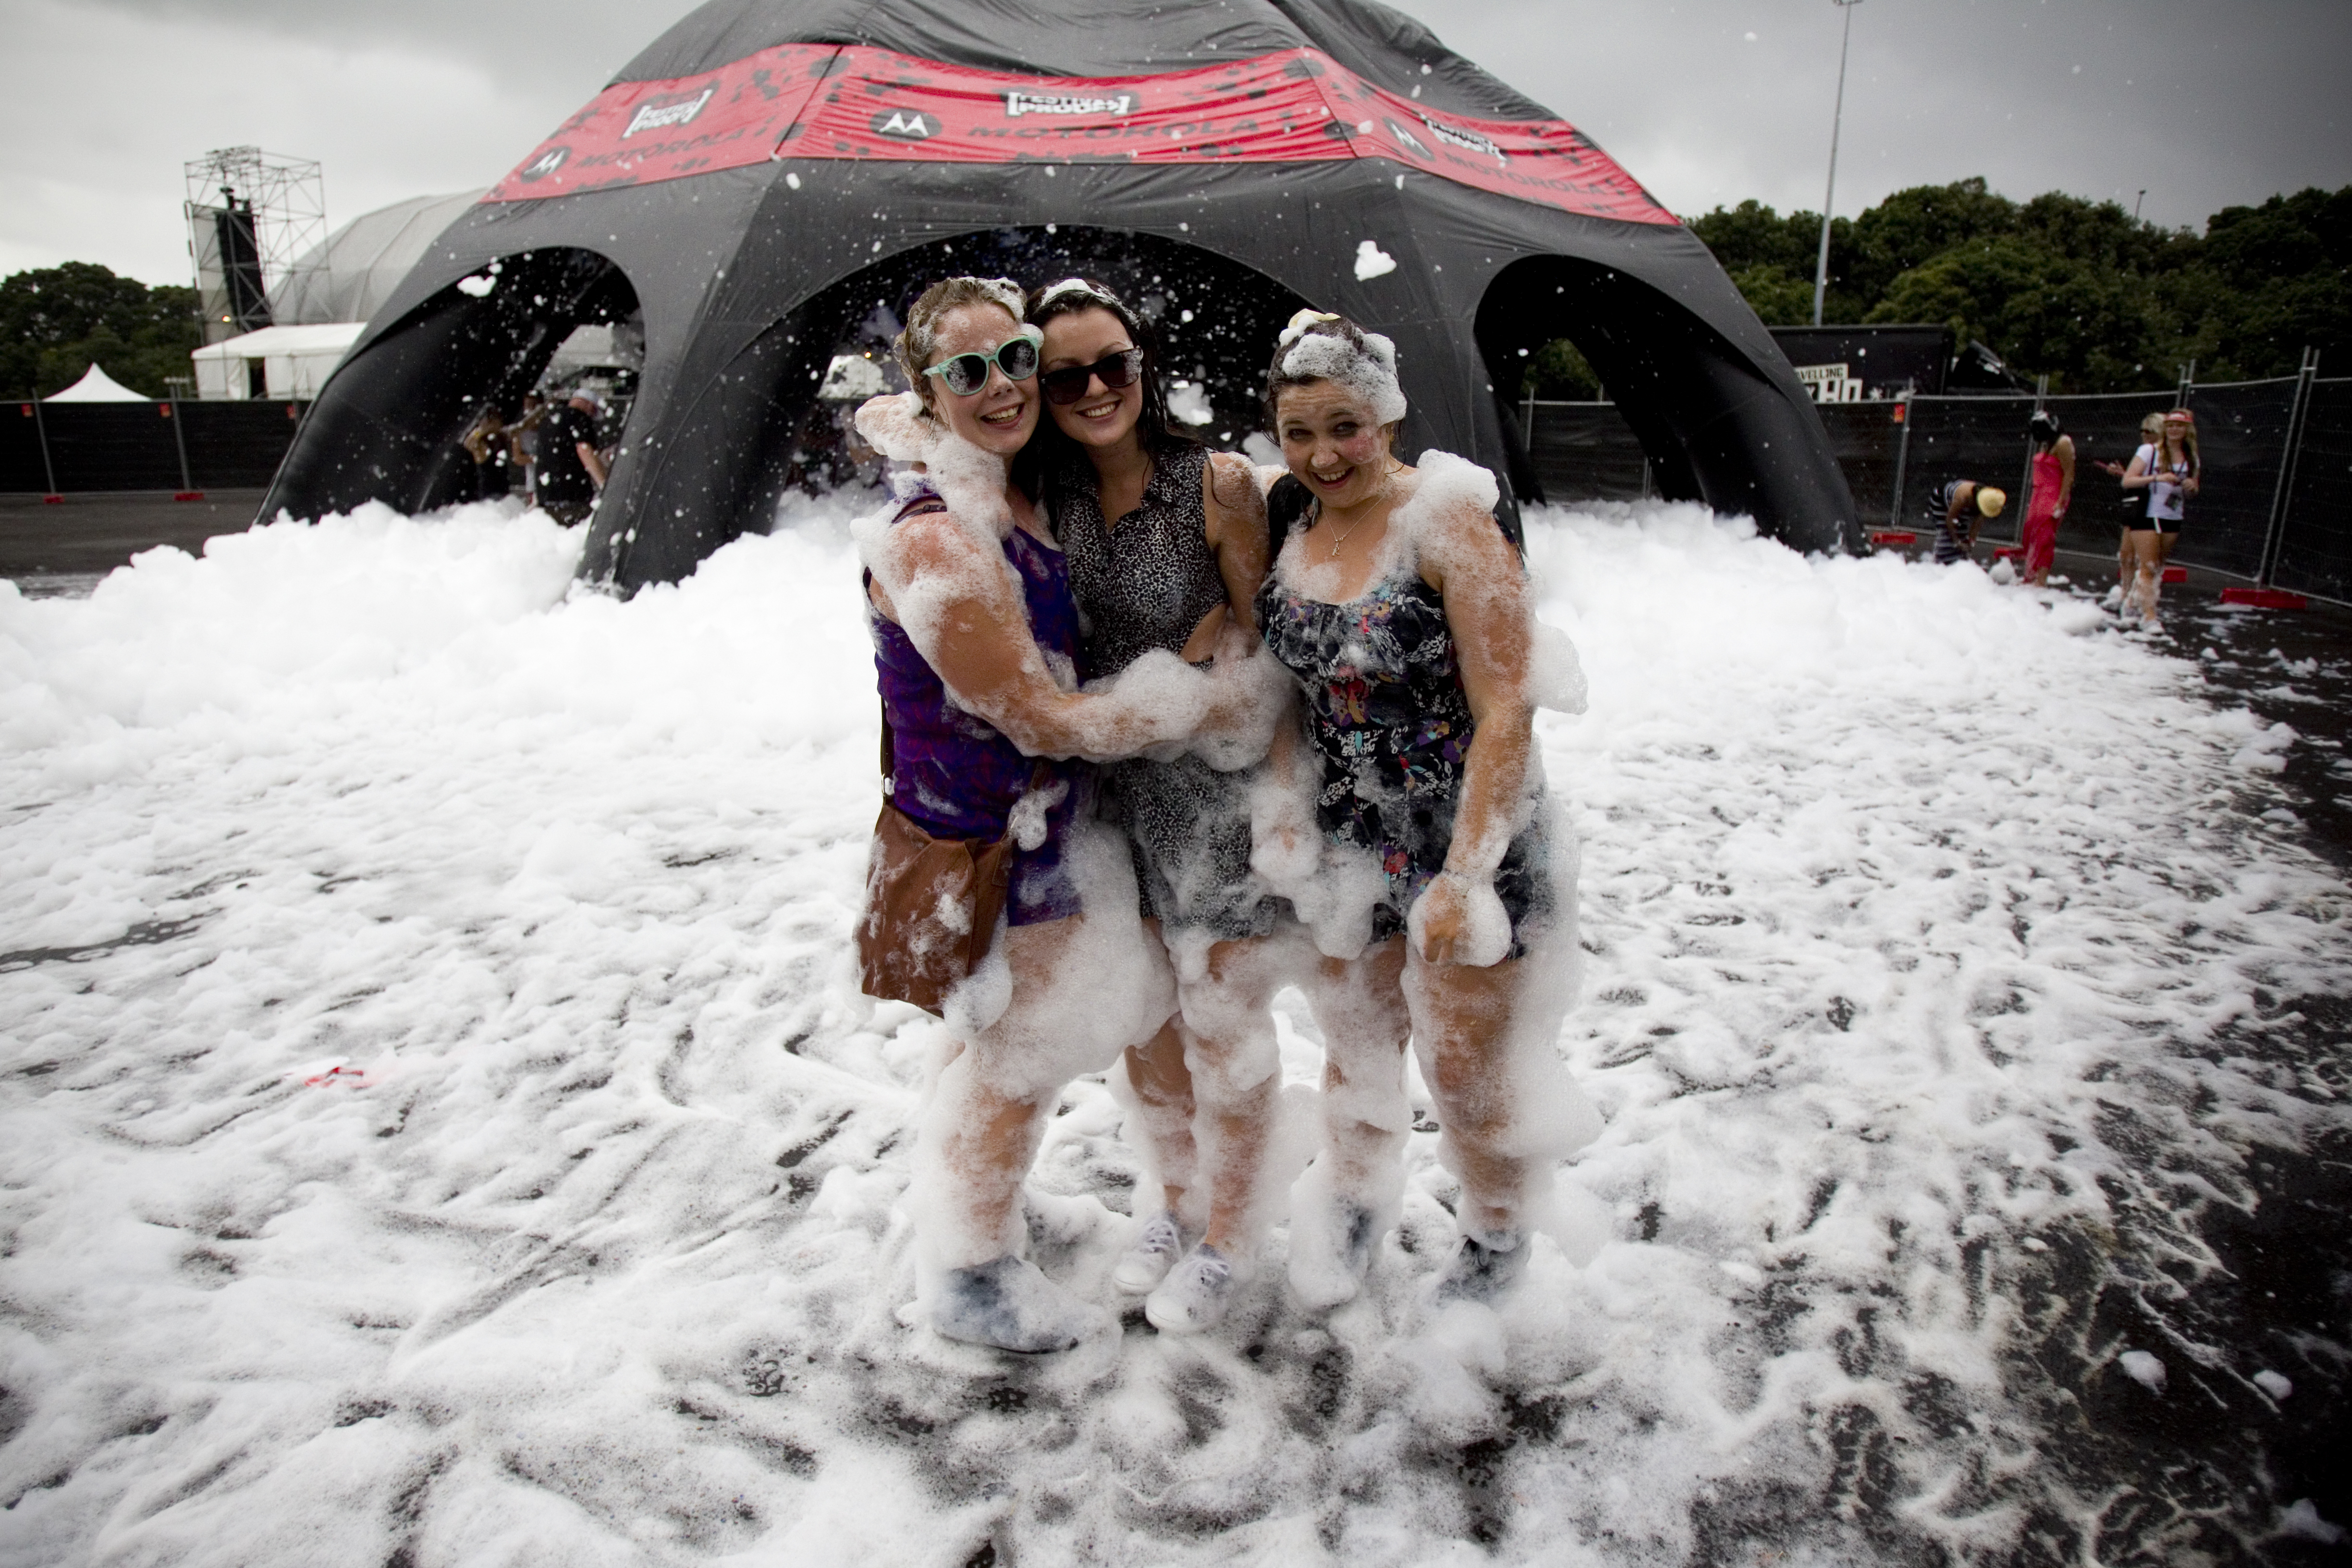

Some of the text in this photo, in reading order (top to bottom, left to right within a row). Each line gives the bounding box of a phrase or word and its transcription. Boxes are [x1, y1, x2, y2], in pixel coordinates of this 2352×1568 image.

[968, 119, 1260, 139] MOTOROLA
[575, 128, 746, 168] MOTOROLA
[1445, 151, 1606, 195] MOTOROLA
[1800, 367, 1843, 380] VELLING
